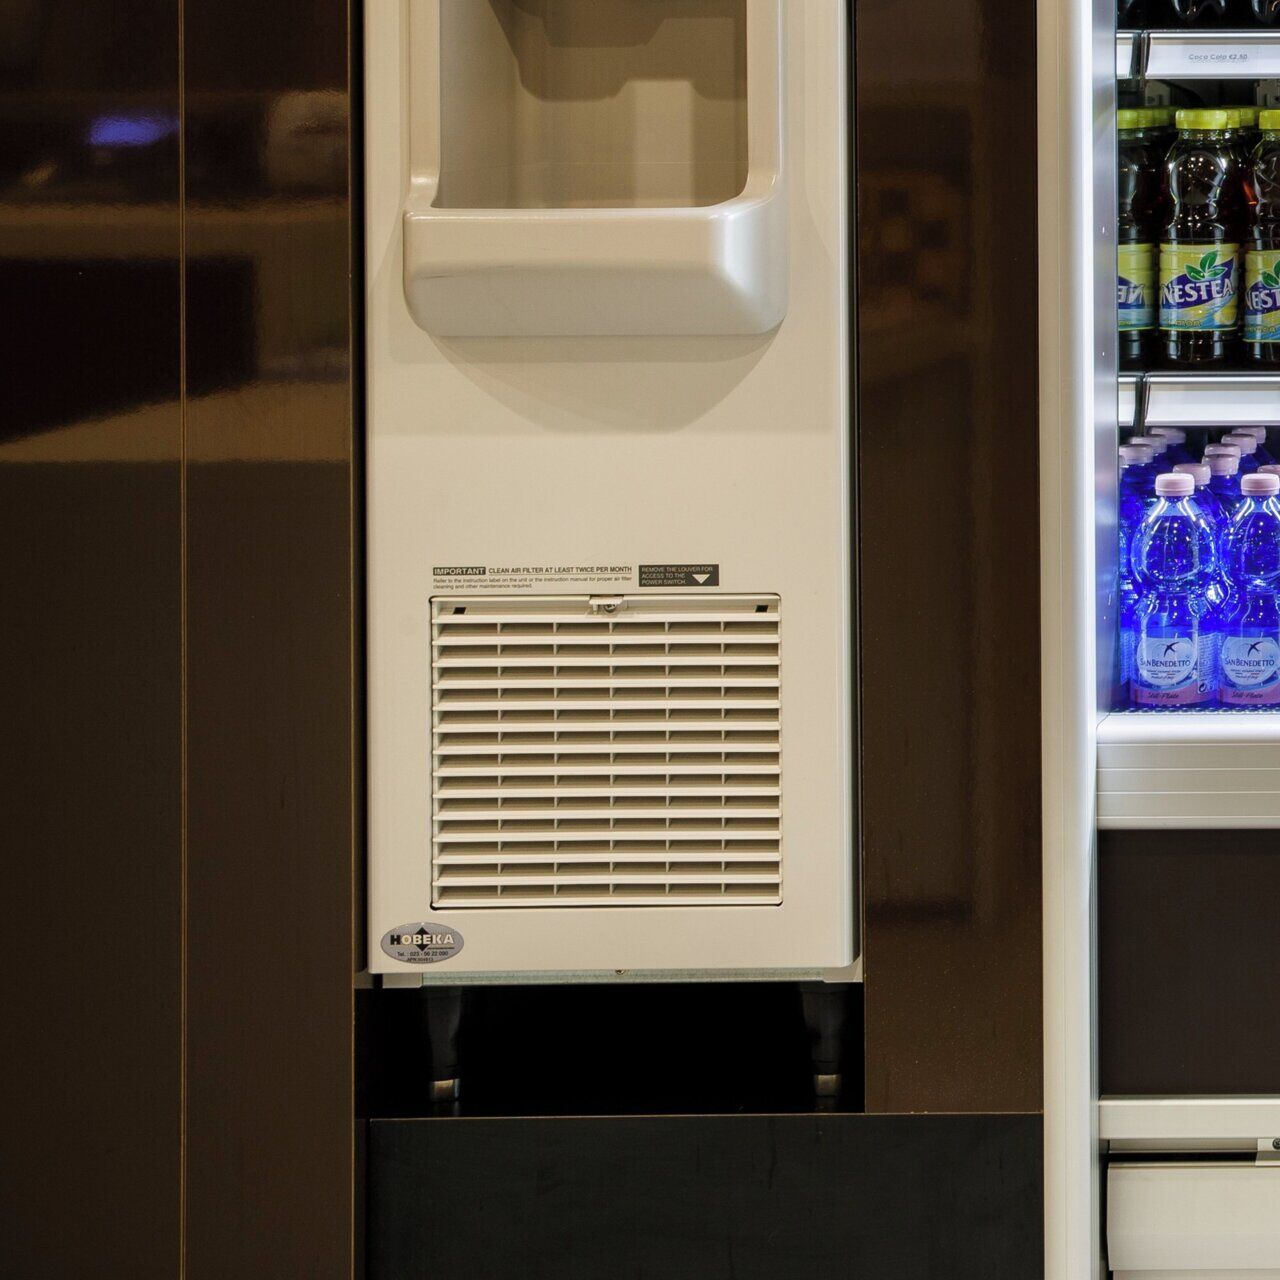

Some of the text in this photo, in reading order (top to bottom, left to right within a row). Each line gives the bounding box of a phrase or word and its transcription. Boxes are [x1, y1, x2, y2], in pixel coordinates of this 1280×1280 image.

[1161, 278, 1234, 305] NESTEA
[434, 567, 485, 575] IMPORTANT
[390, 934, 454, 946] HOBEKA
